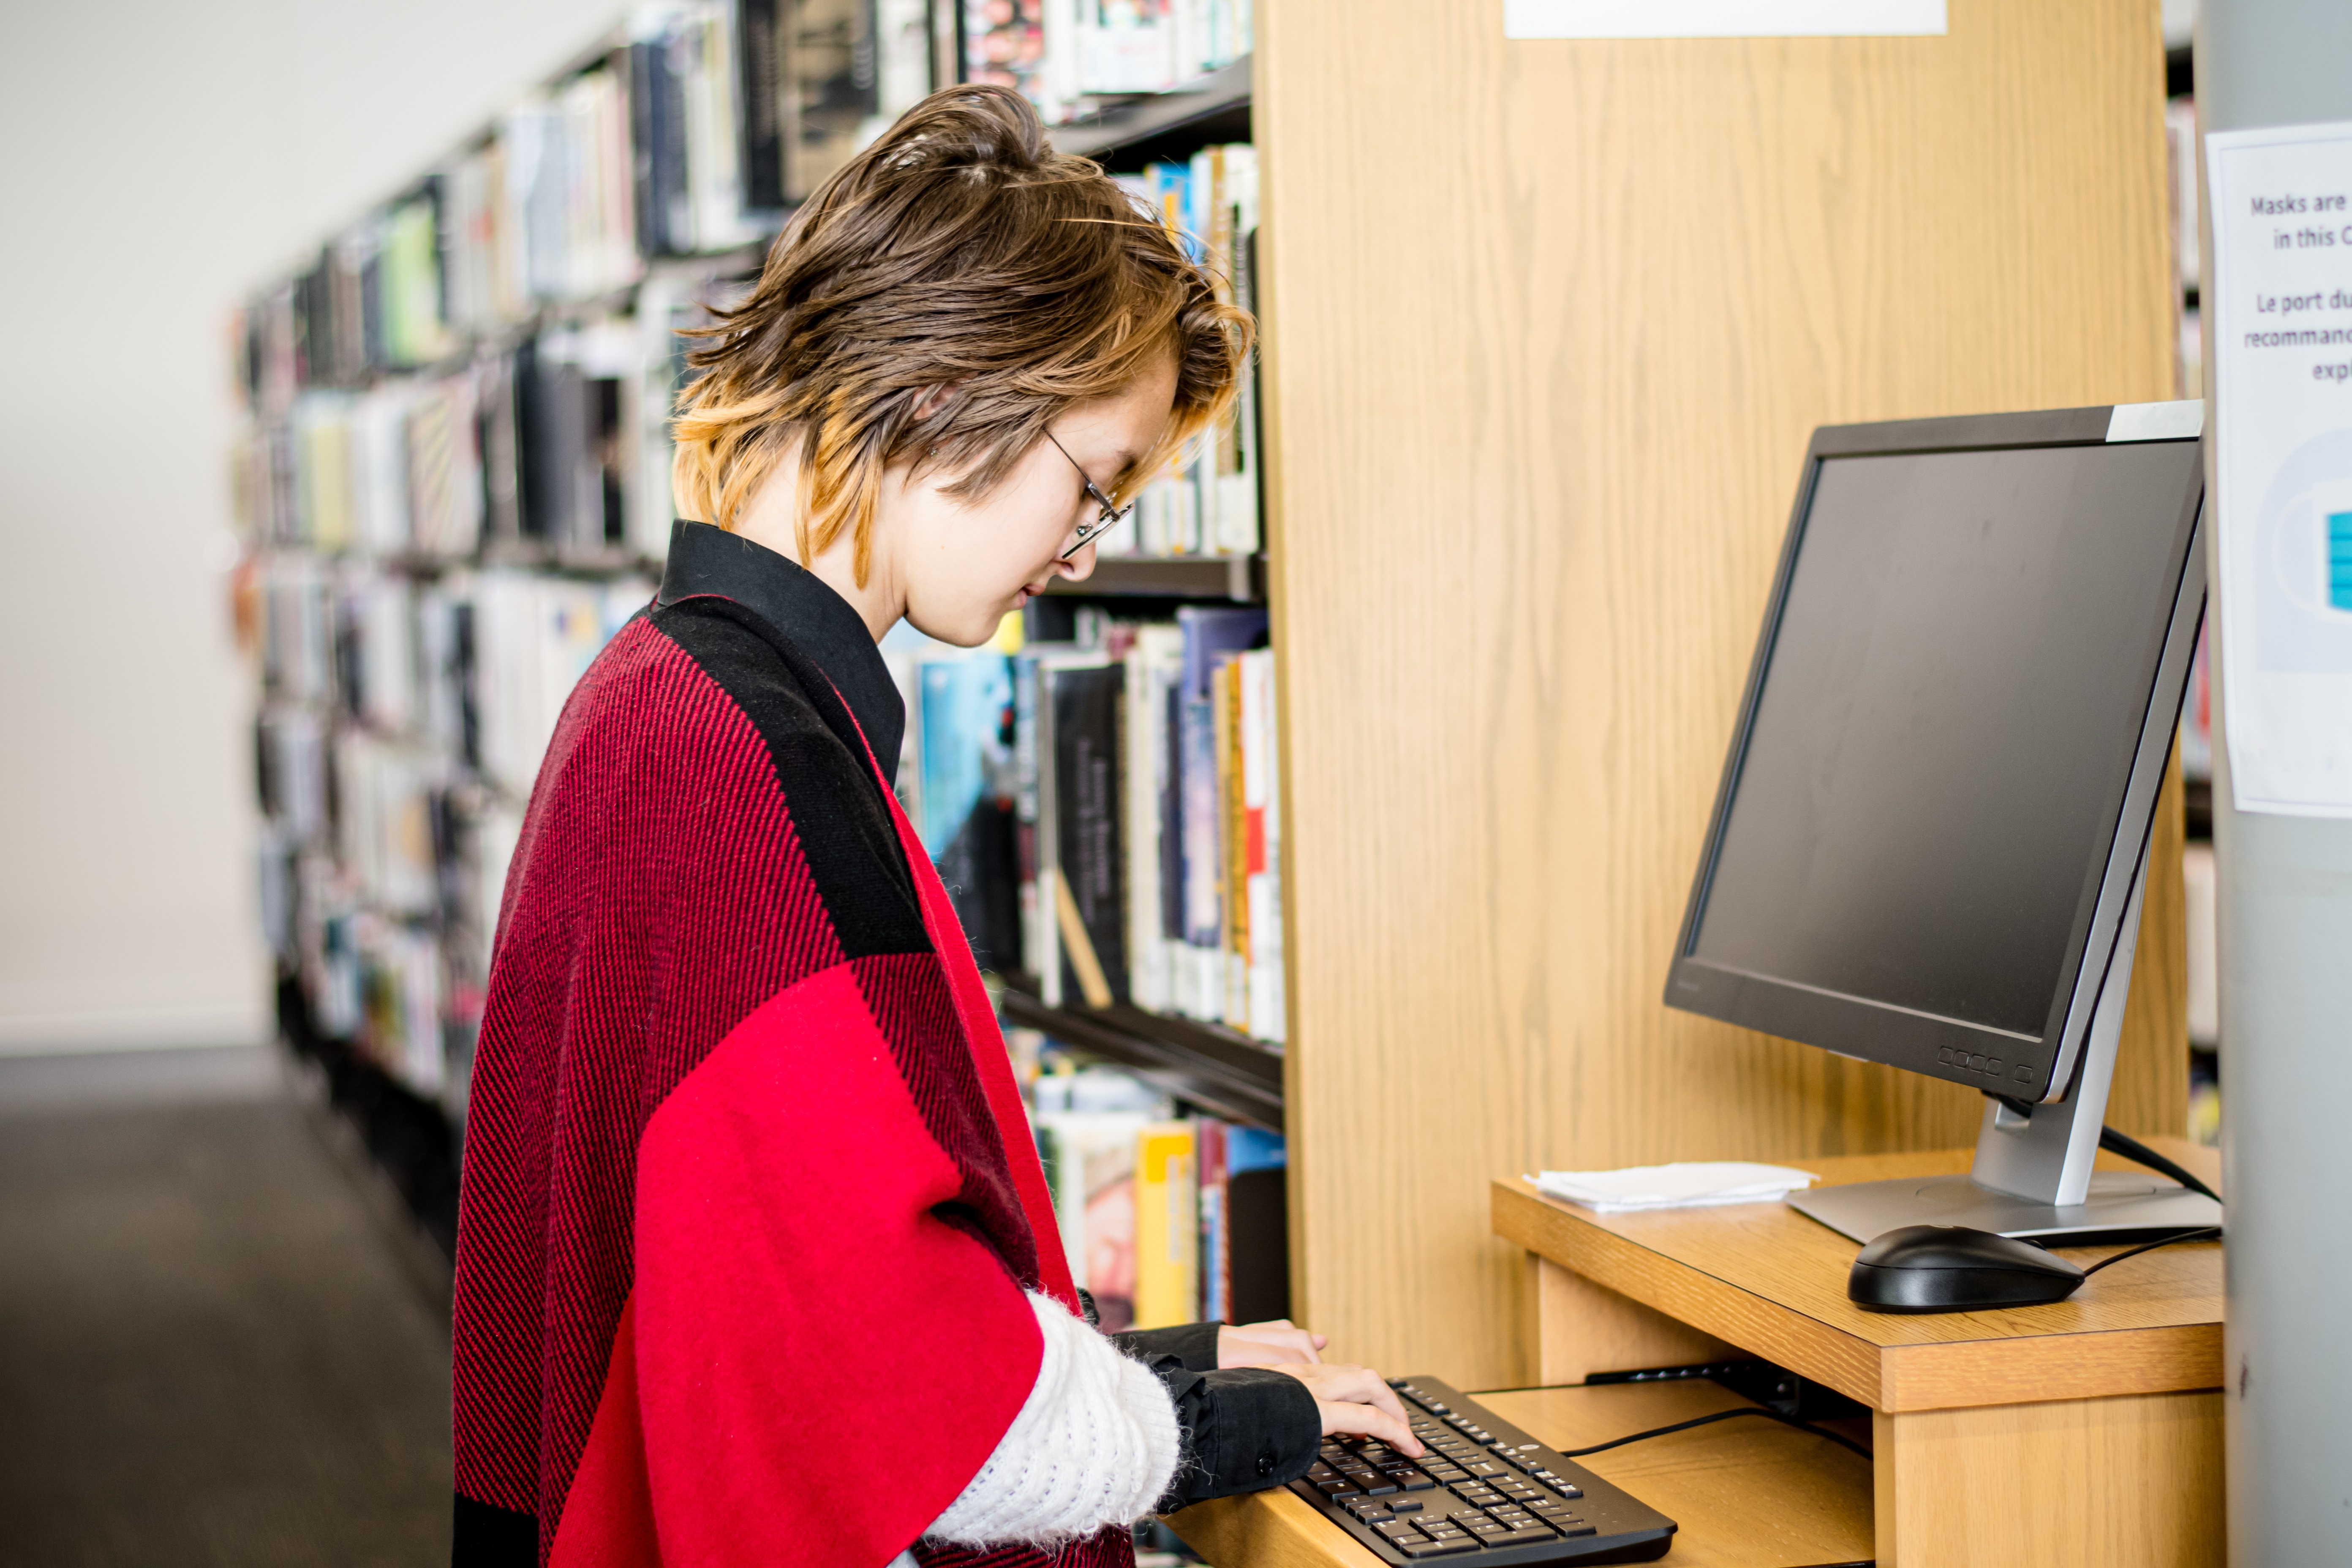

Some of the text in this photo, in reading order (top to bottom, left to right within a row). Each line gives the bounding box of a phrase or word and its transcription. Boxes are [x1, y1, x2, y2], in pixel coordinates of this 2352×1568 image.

[2251, 194, 2347, 215] Masks are
[2275, 230, 2291, 248] in
[2297, 227, 2335, 248] this
[2257, 295, 2276, 313] Le
[2282, 293, 2323, 316] port
